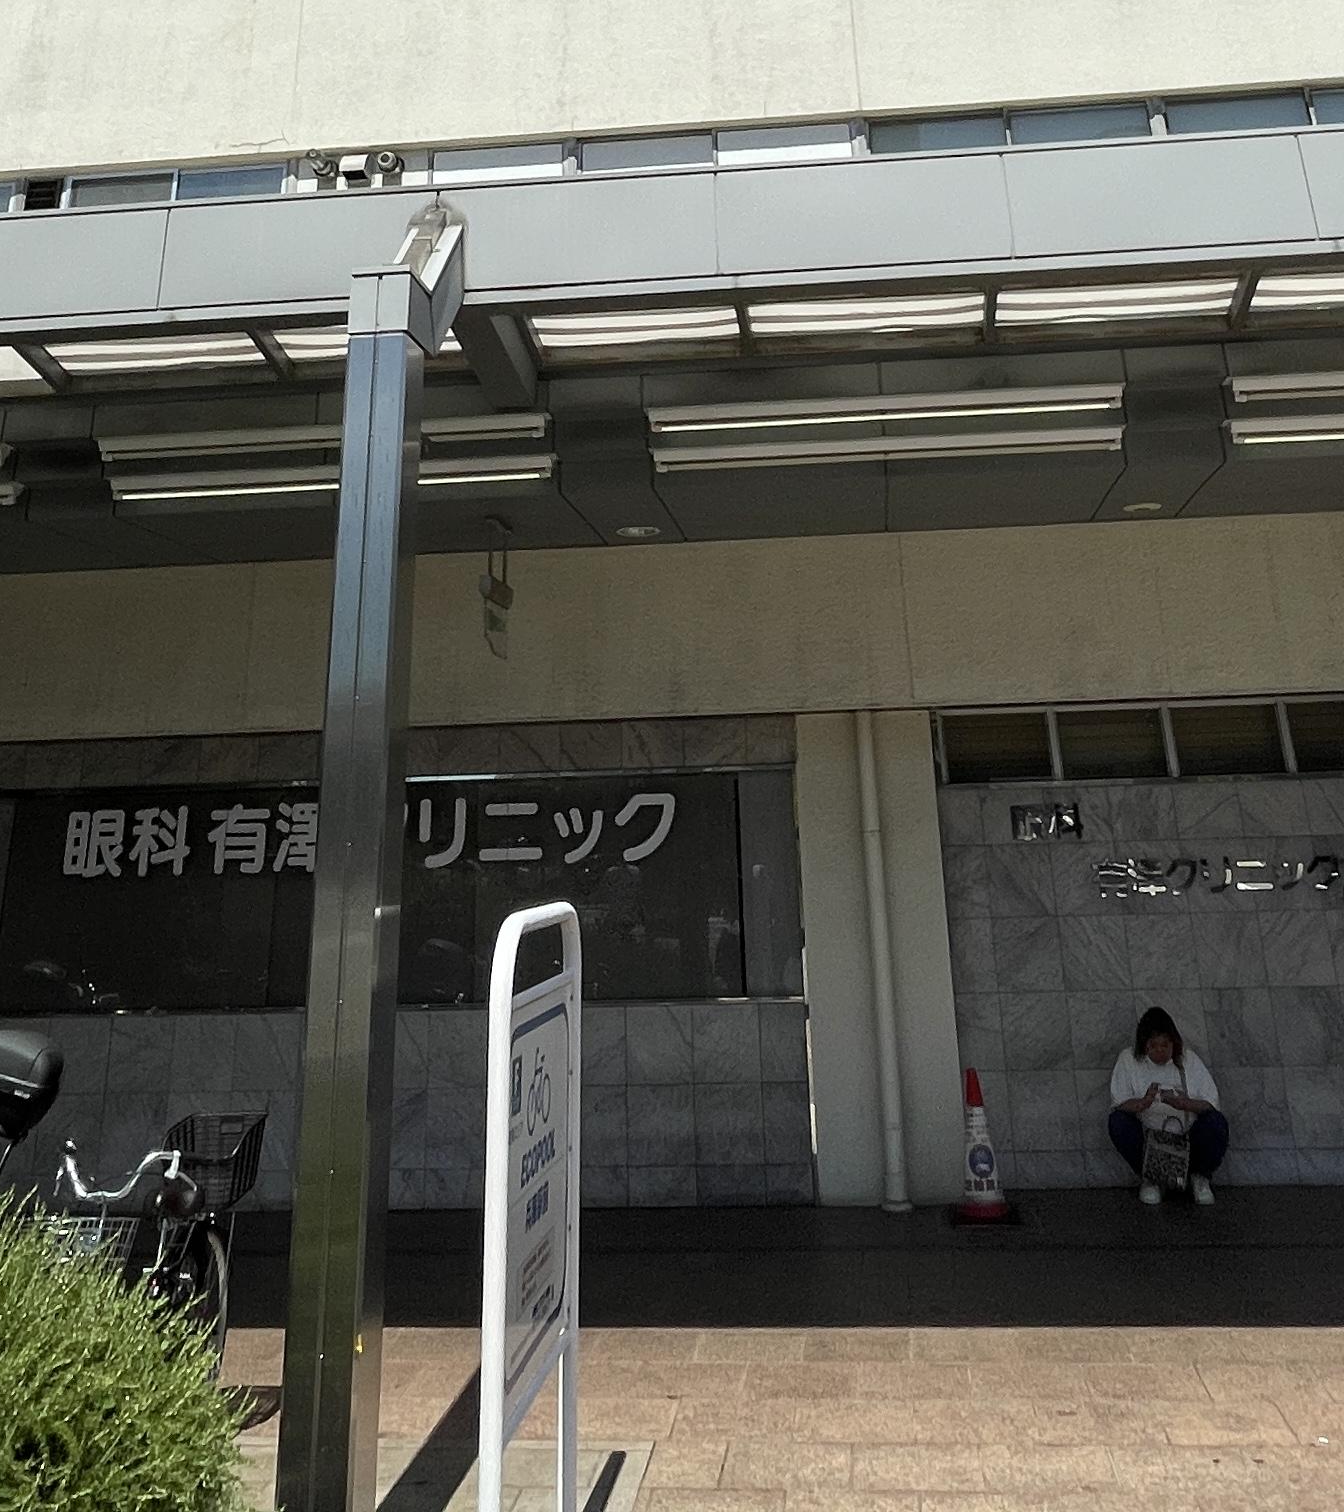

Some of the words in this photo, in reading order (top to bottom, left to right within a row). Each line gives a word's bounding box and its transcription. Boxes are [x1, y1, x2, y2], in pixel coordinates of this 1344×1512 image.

[63, 805, 191, 877] 眼科
[207, 792, 676, 875] 有澤リニック
